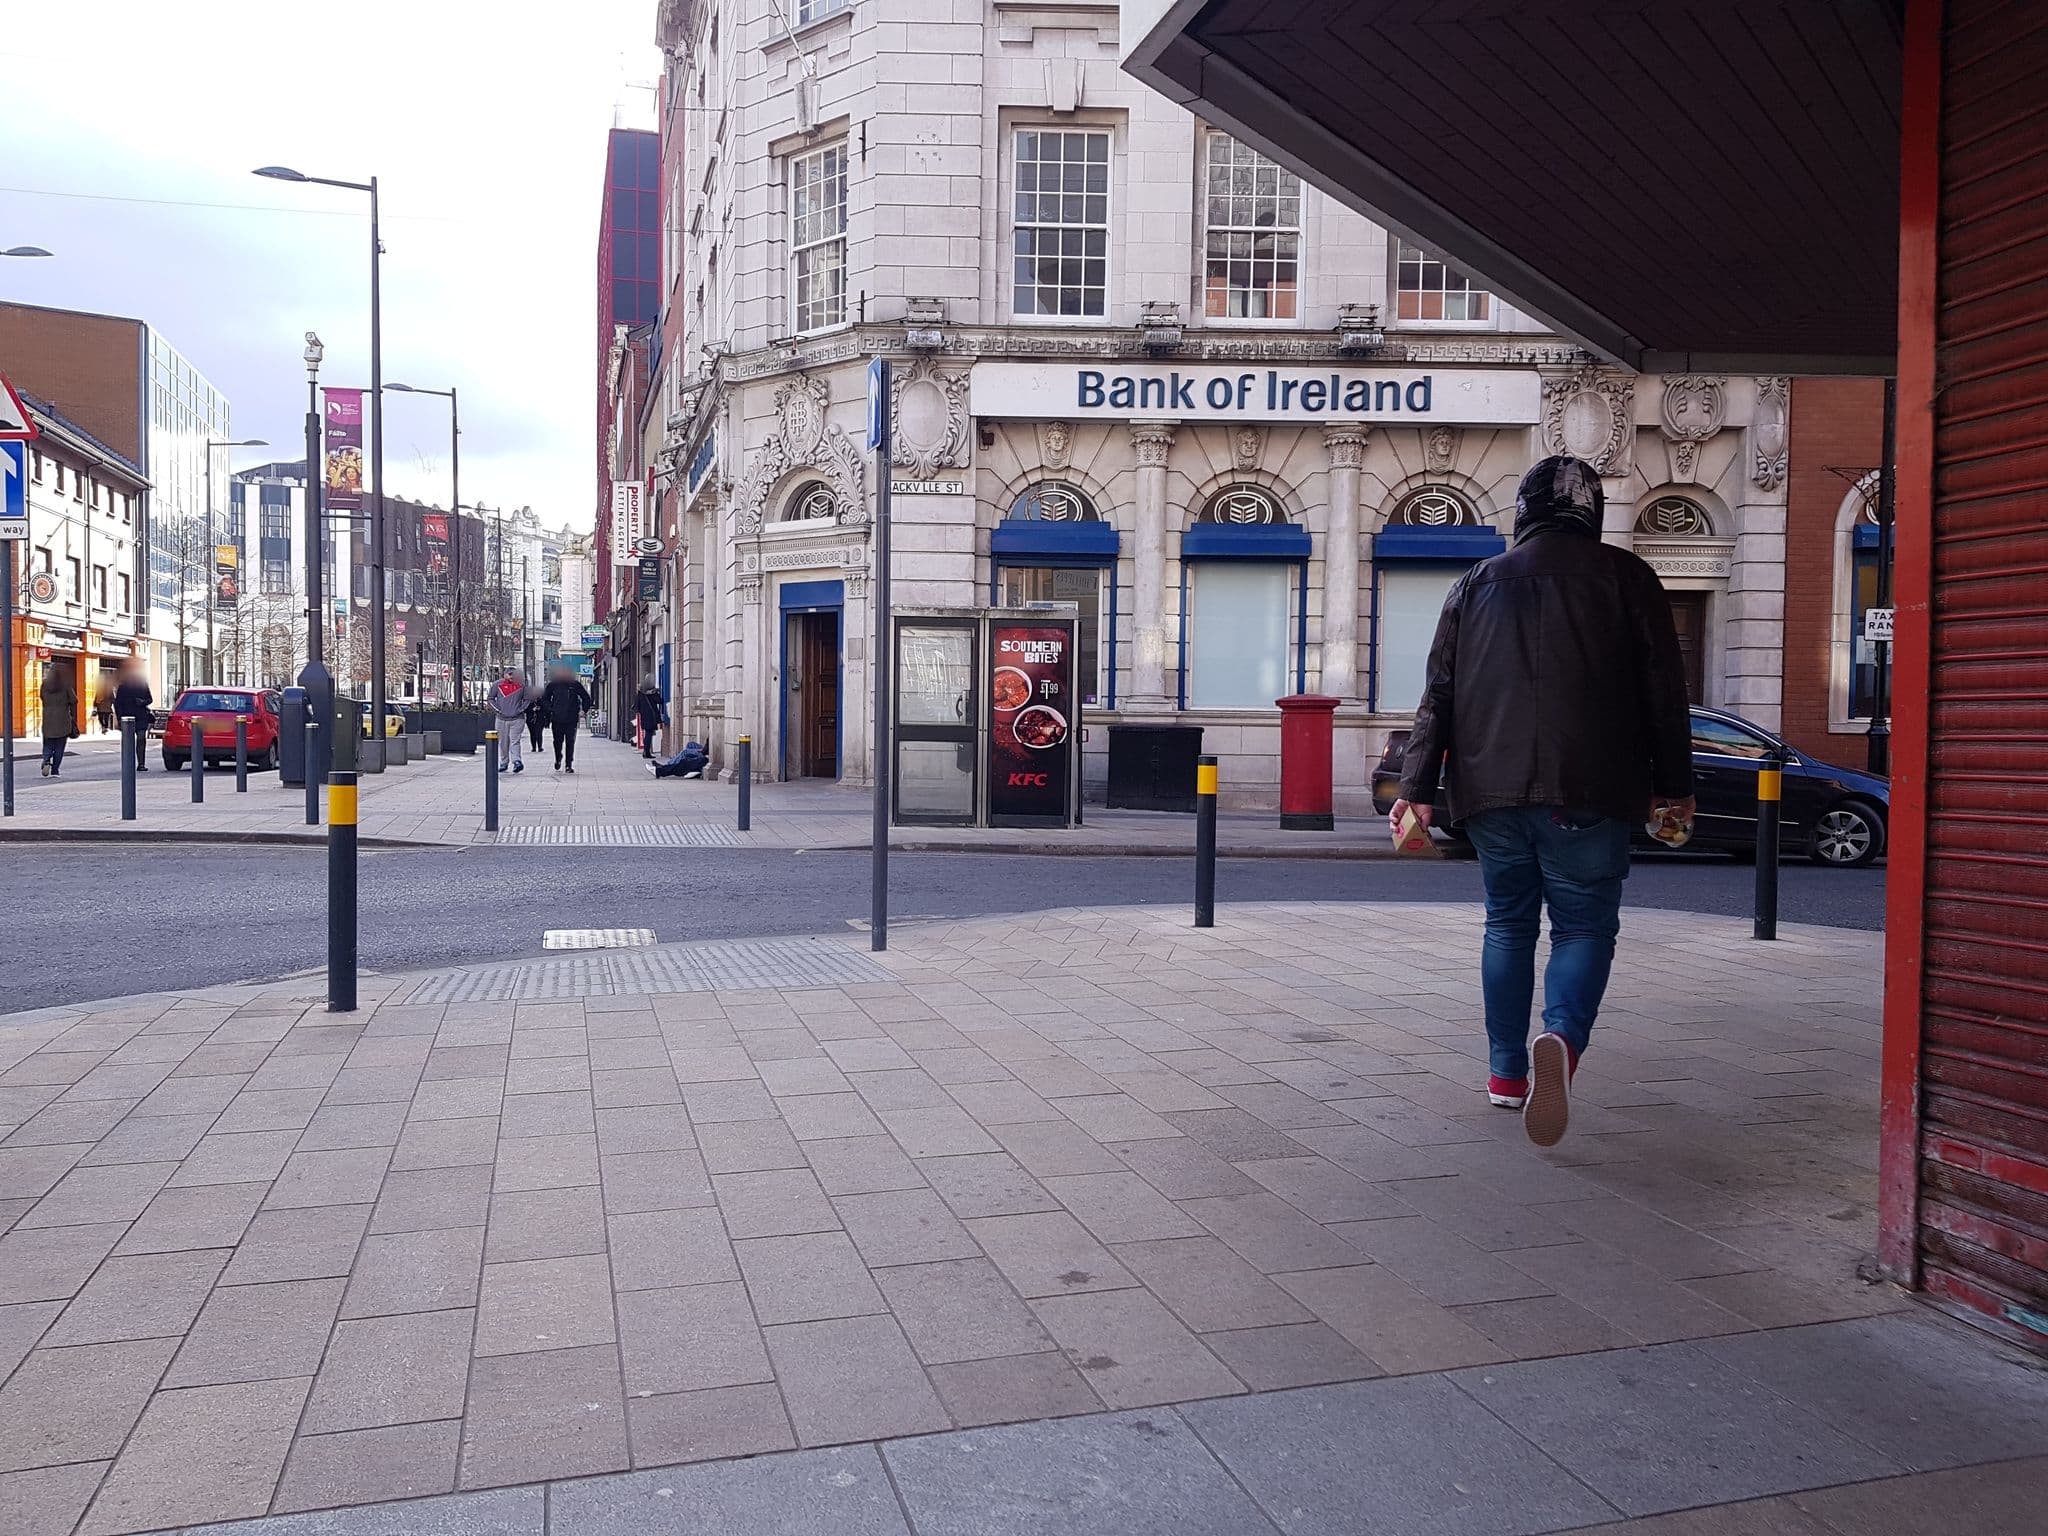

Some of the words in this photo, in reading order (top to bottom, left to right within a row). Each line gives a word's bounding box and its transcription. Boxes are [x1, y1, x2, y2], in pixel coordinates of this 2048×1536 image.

[1077, 370, 1196, 409] Bank
[1205, 373, 1256, 410] of
[1267, 371, 1432, 412] Ireland
[893, 482, 941, 493] ACKVLLE
[946, 483, 960, 493] ST
[627, 486, 638, 534] PROPERTY
[3, 526, 24, 535] way
[1873, 612, 1894, 620] TAX
[1869, 622, 1894, 630] RAN
[1000, 640, 1062, 652] SOUTHERN
[1024, 652, 1058, 664] BITES
[1008, 773, 1048, 786] KFC
